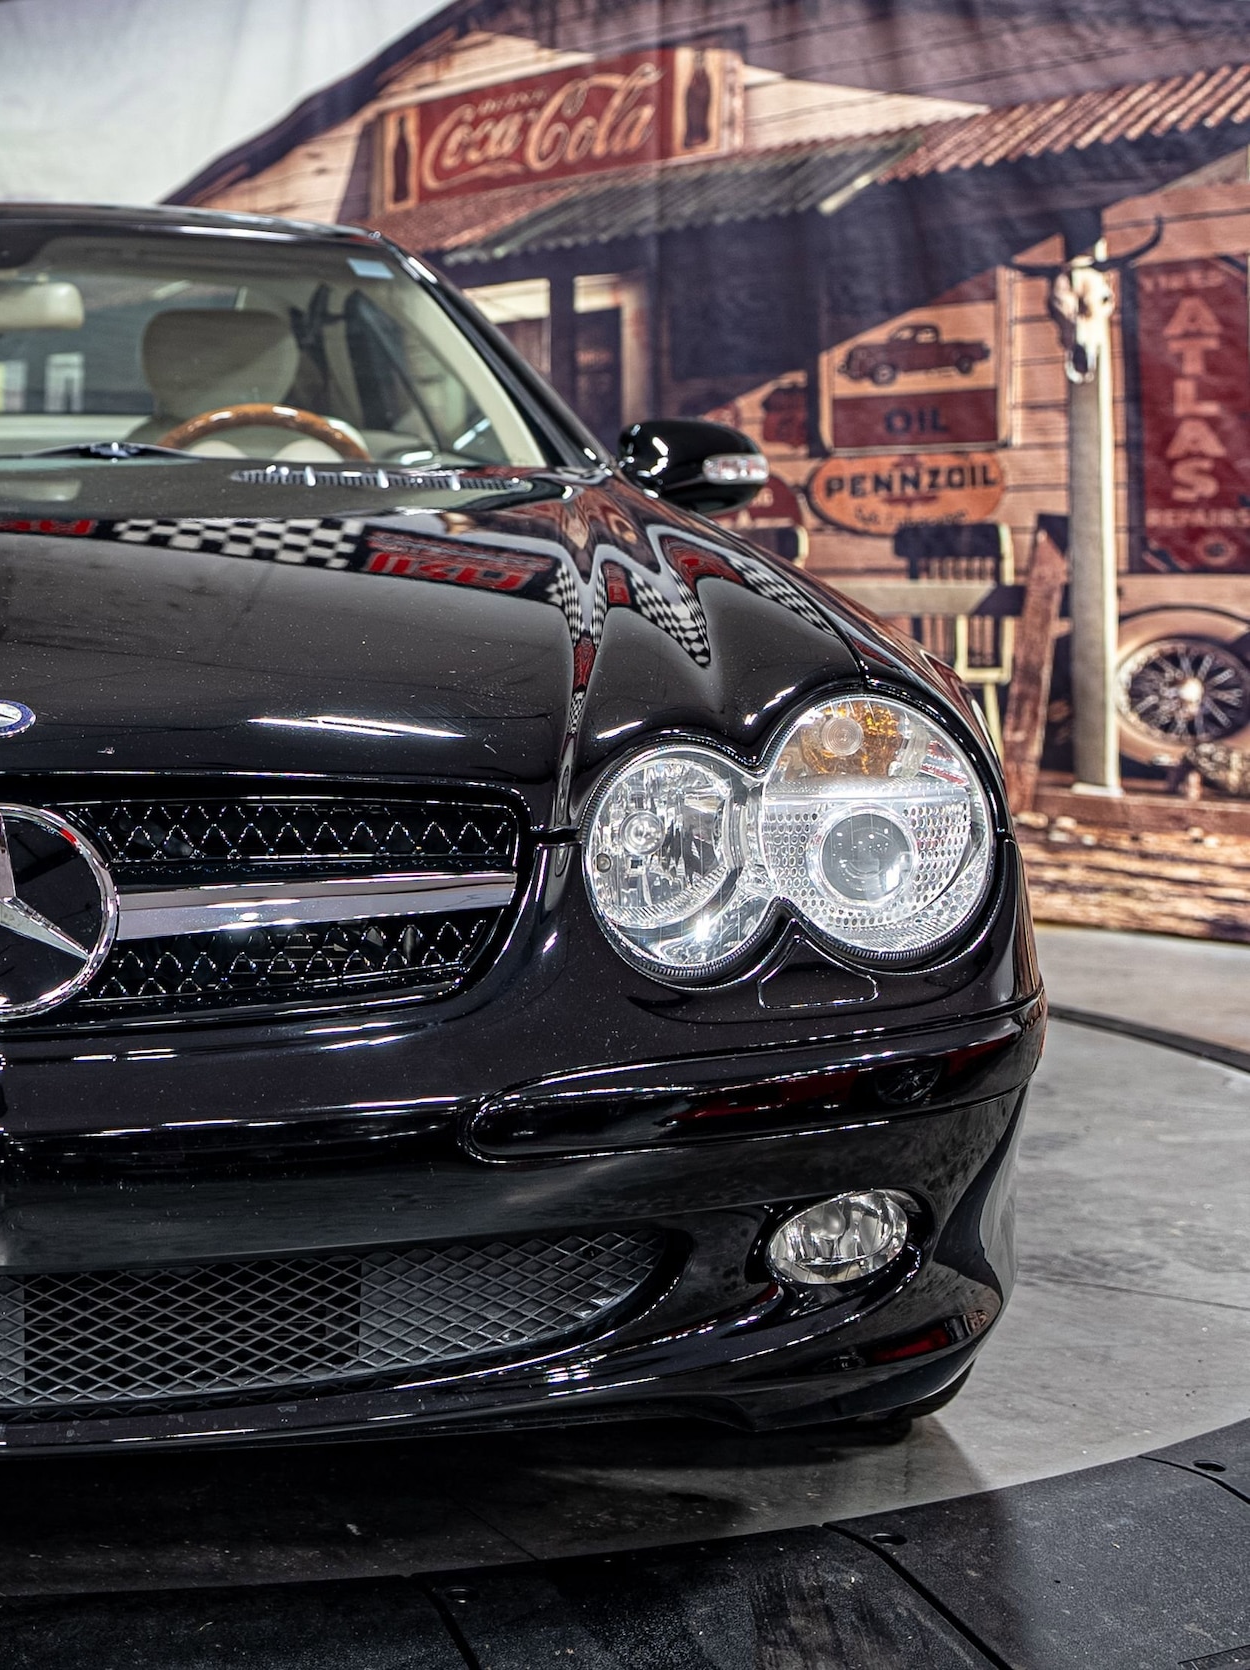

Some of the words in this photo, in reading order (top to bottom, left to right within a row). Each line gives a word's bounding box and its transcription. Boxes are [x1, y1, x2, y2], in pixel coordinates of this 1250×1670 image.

[421, 61, 664, 191] Coca-Cola
[883, 407, 949, 435] OIL
[1162, 296, 1228, 503] ATLAS
[824, 464, 998, 499] PENNZOIL
